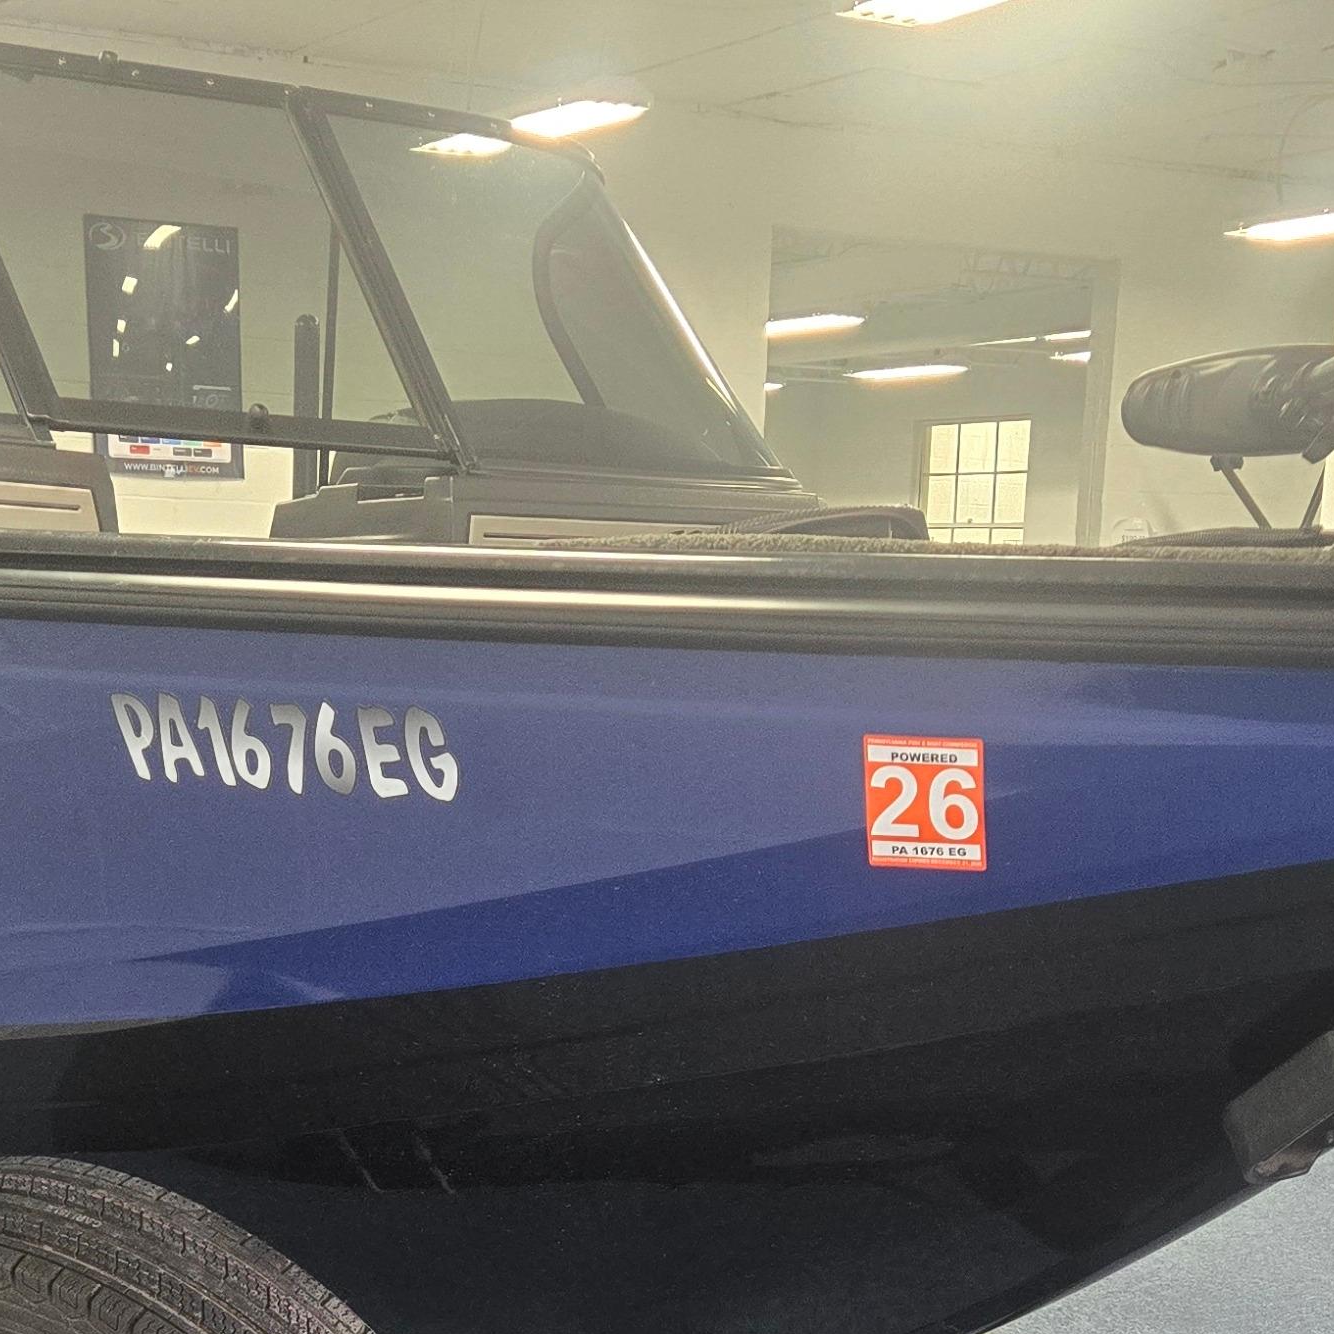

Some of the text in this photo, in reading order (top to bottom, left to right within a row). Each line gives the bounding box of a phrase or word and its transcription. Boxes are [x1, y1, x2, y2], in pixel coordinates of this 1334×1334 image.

[111, 692, 459, 802] PA1676EG
[891, 751, 958, 763] POWERED
[870, 765, 979, 840] 26
[892, 845, 967, 857] PA 1676 EG
